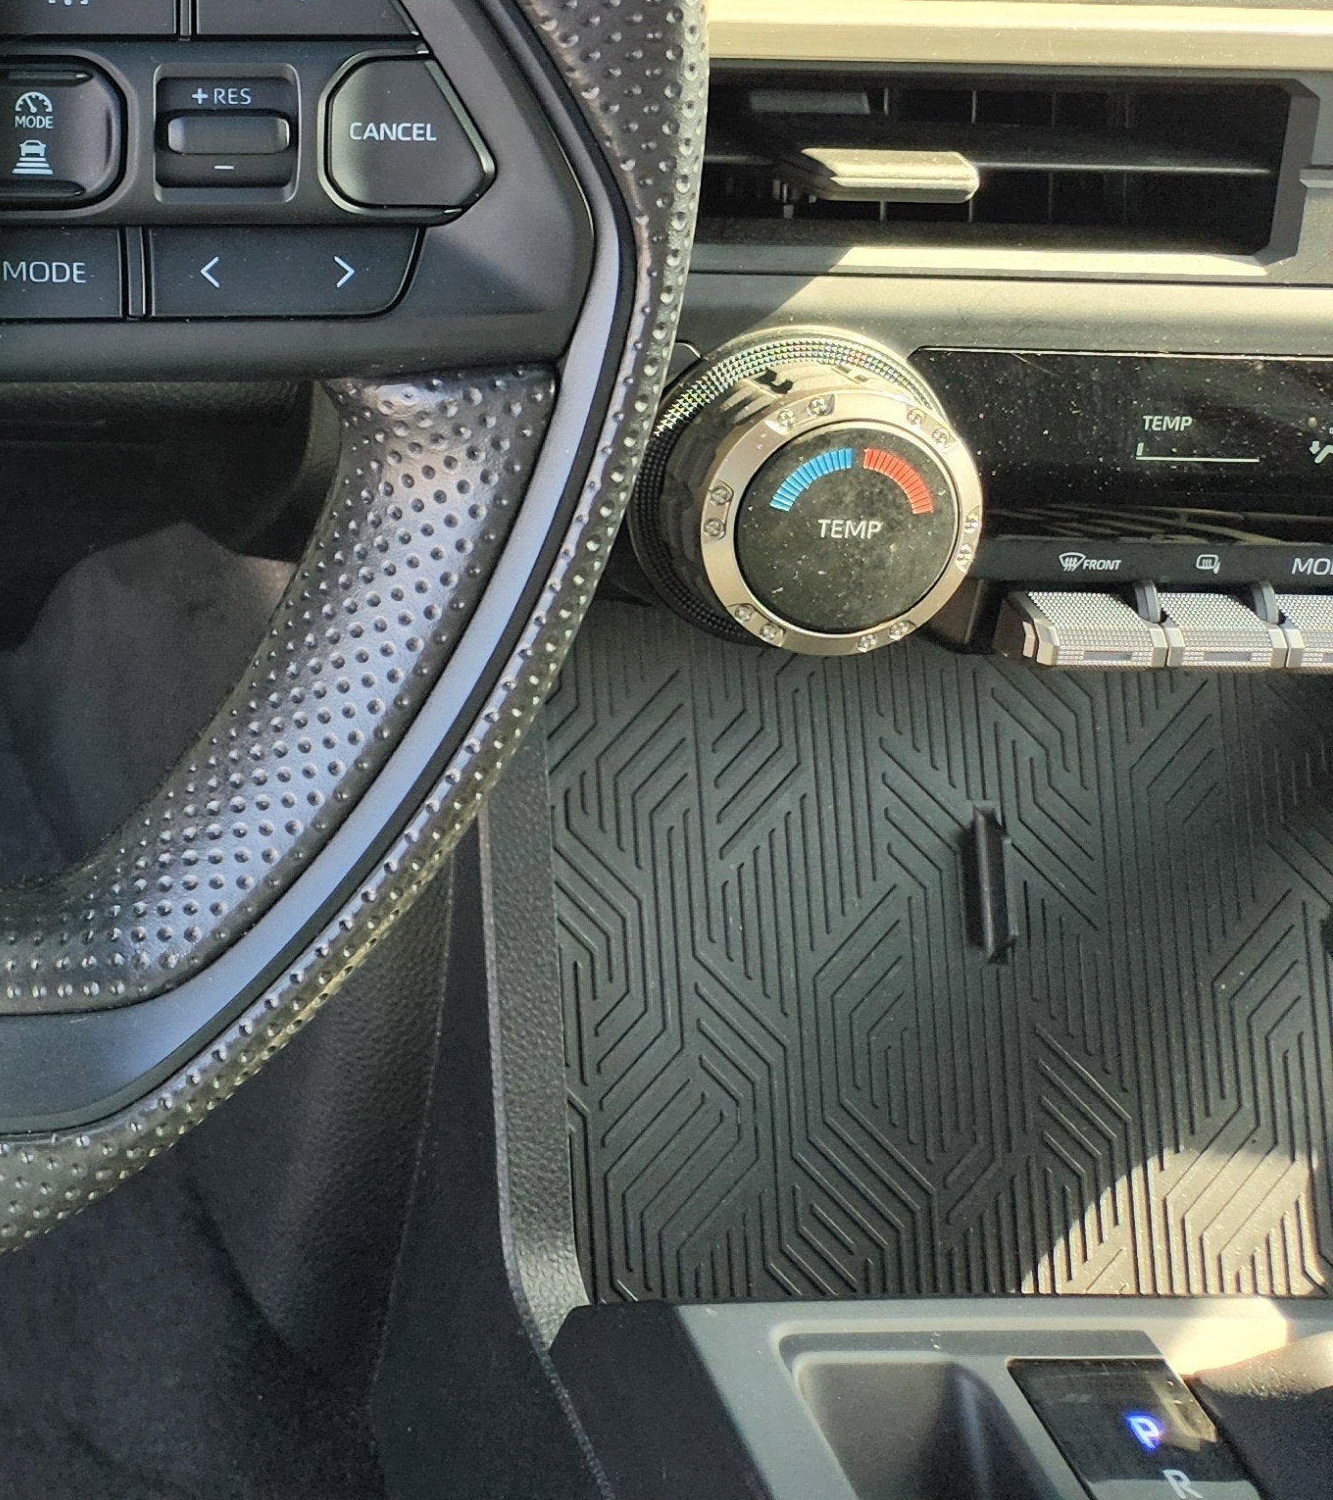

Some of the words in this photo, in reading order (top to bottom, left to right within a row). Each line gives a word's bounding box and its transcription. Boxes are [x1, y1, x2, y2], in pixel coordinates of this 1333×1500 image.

[14, 114, 54, 130] MODE
[348, 121, 437, 142] CANCEL
[1, 259, 88, 285] MODE
[1141, 414, 1194, 432] TEMP
[817, 518, 883, 540] TEMP
[1082, 558, 1123, 572] FRONT
[1125, 1413, 1161, 1449] P
[1162, 1468, 1204, 1499] R
